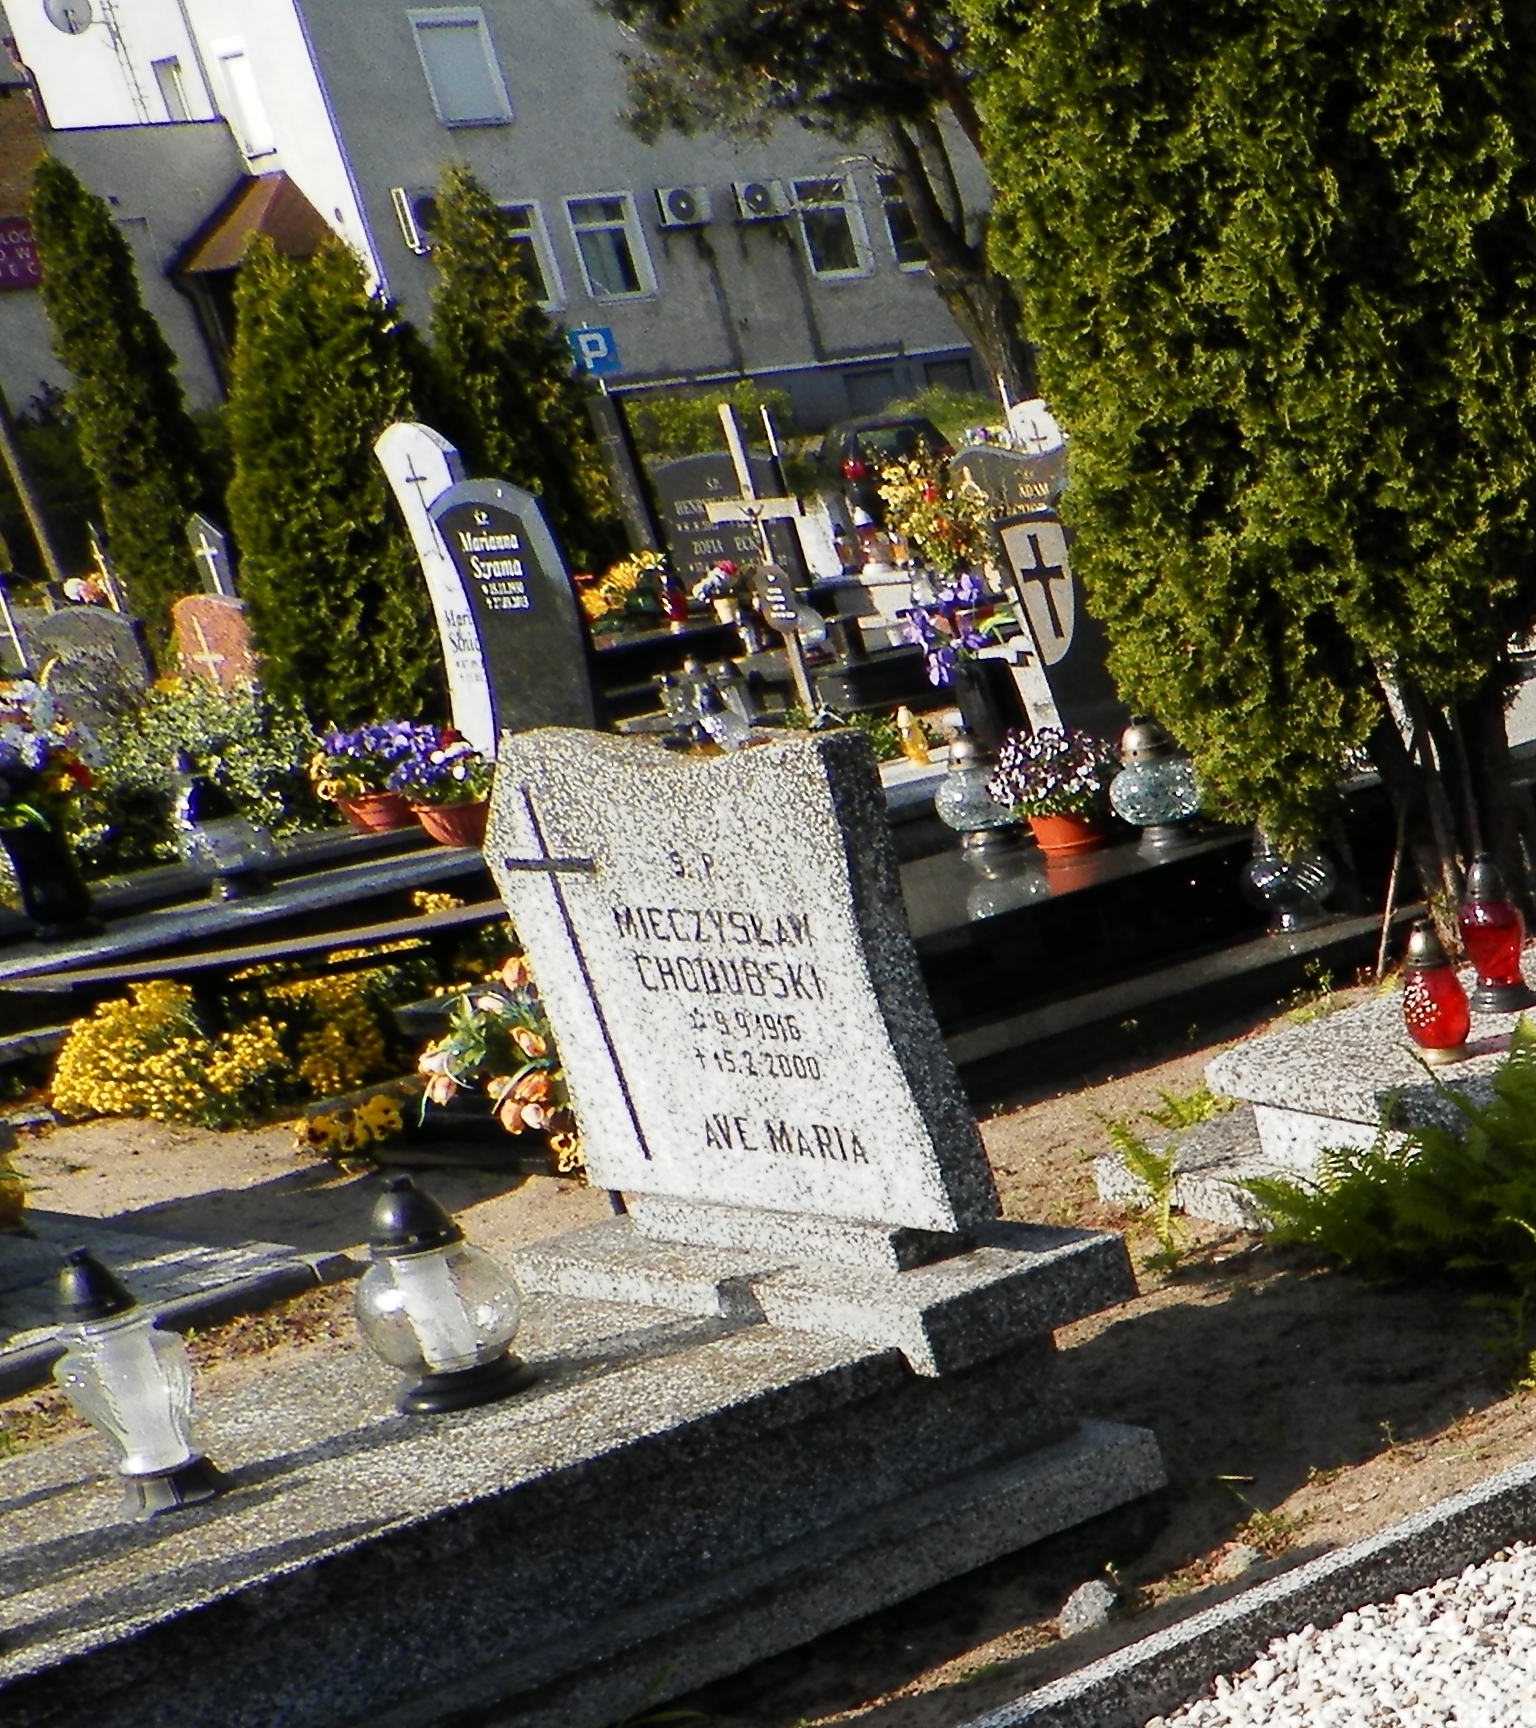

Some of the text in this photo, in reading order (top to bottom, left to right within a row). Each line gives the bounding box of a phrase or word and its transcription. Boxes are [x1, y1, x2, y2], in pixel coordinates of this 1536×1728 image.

[577, 333, 608, 369] P
[609, 904, 818, 949] MIECZYSŁAW
[632, 950, 828, 1000] CHODUBSKI
[703, 1113, 870, 1166] AVE MARIA
